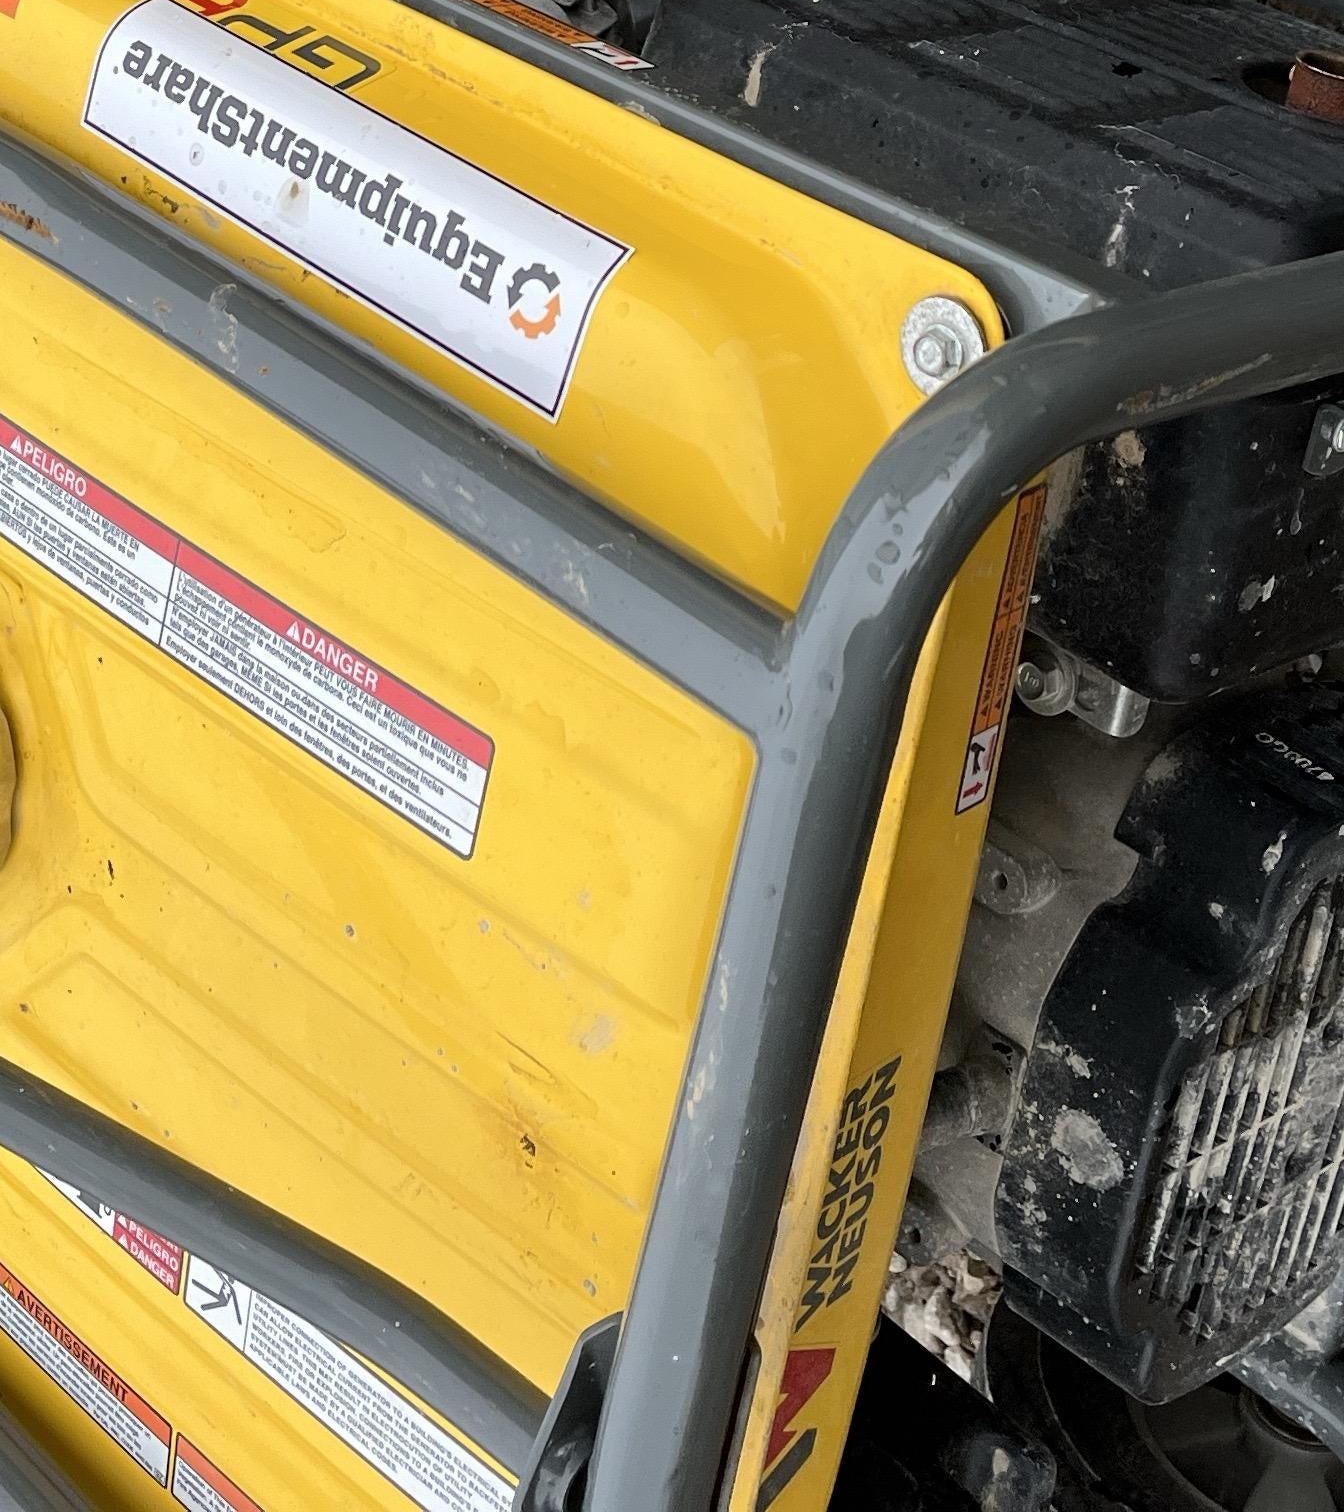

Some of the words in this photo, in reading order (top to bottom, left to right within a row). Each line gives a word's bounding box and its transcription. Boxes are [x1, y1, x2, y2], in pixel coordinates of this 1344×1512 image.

[122, 40, 505, 305] EquipmentShare
[21, 438, 88, 500] PELIGRO
[299, 626, 379, 694] DANGER
[794, 1072, 873, 1334] WACKER
[825, 1055, 902, 1308] NEUSON
[127, 1221, 179, 1272] PELIGRO
[129, 1241, 176, 1287] DANGER
[17, 1285, 128, 1406] AVERTISSEMENT
